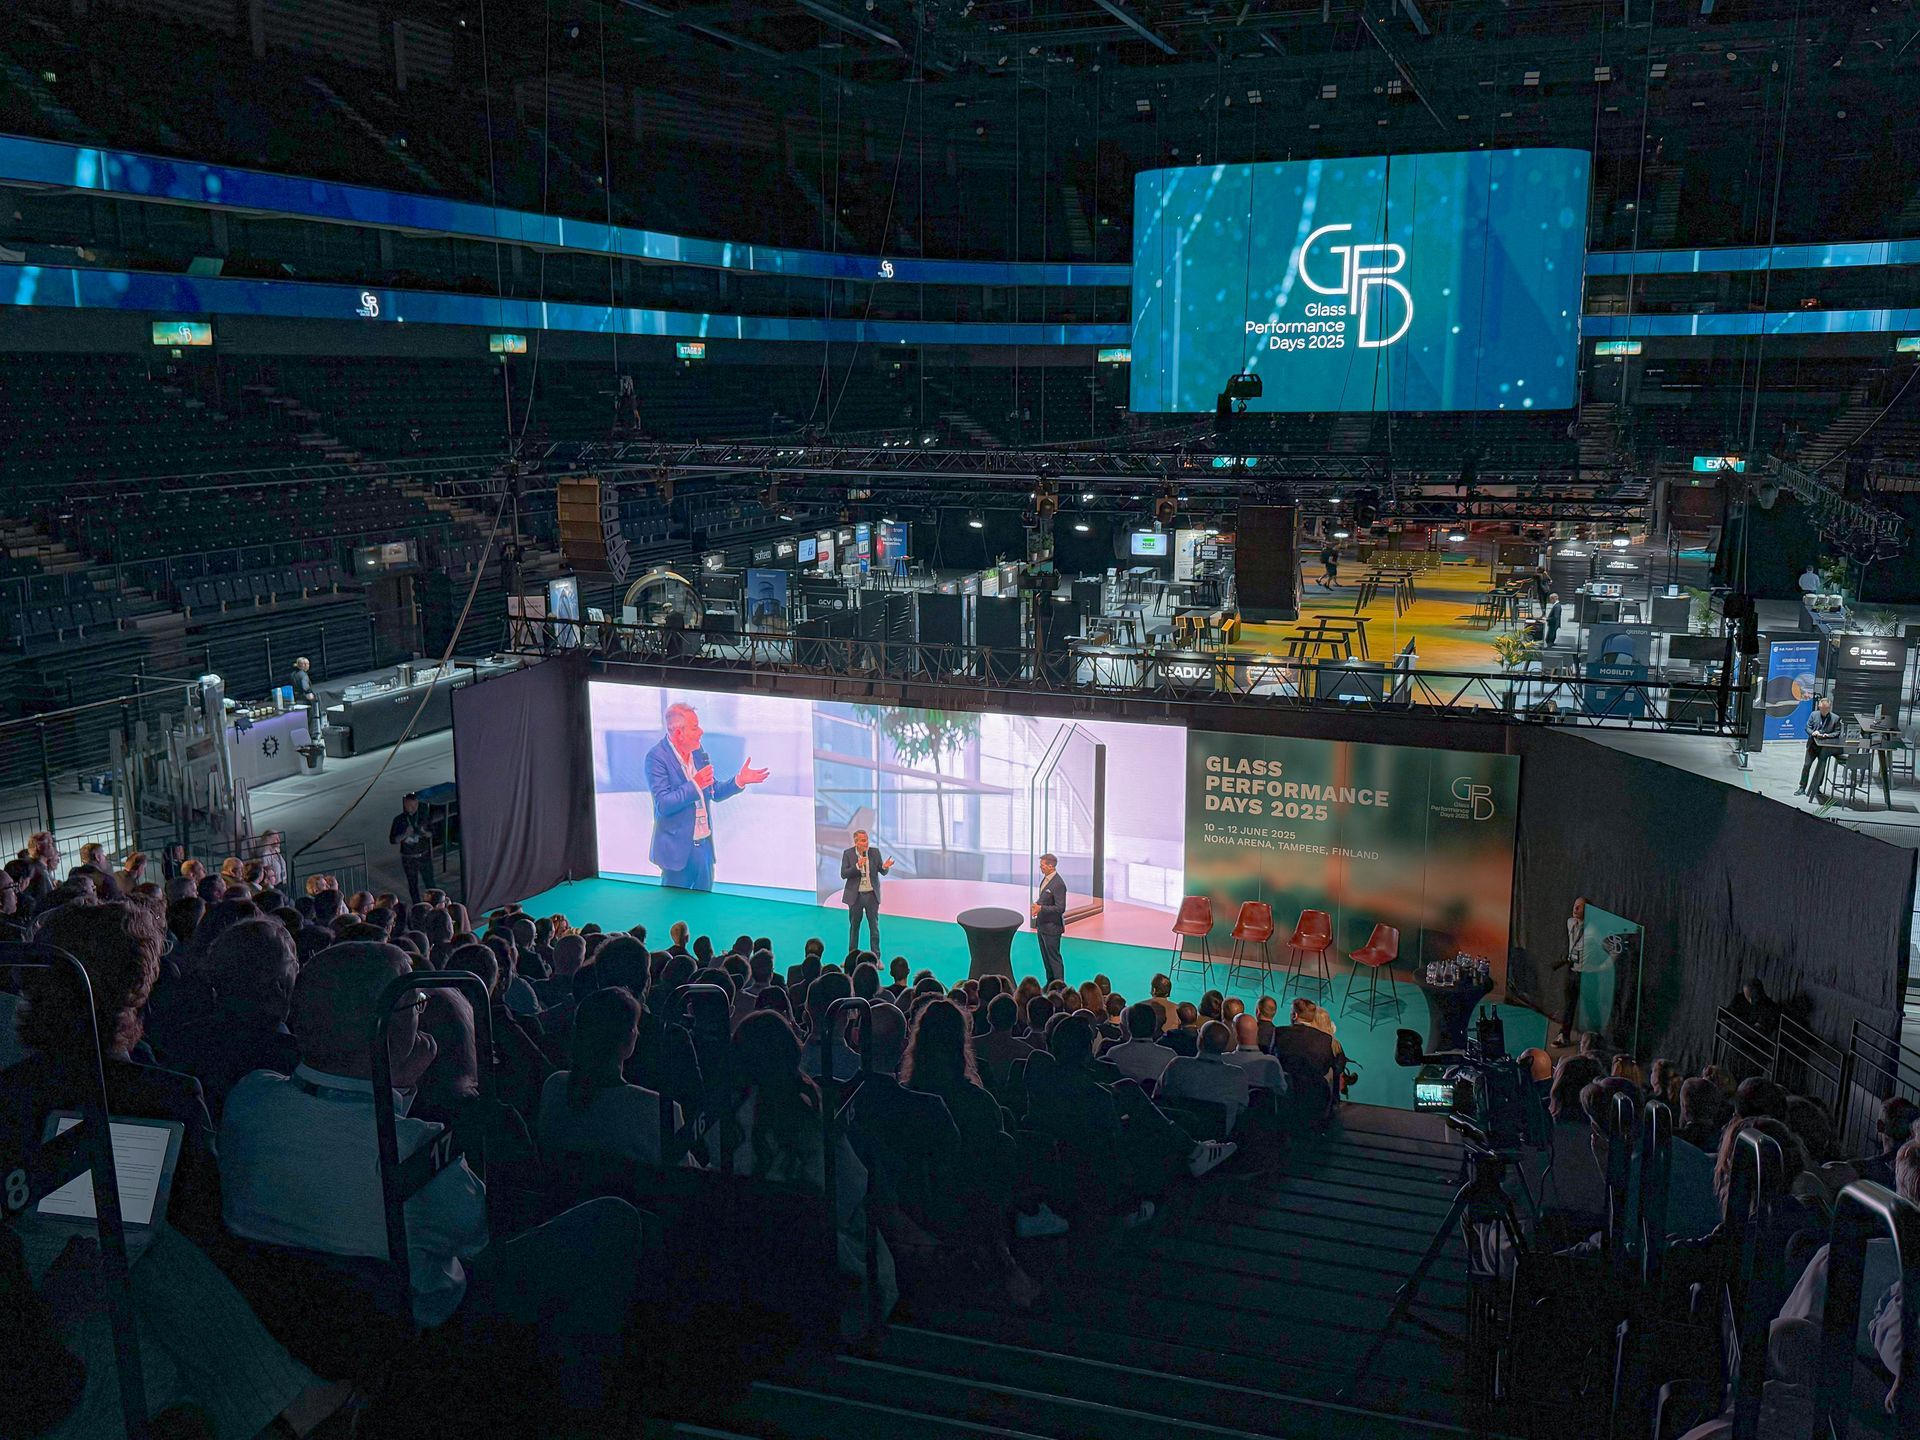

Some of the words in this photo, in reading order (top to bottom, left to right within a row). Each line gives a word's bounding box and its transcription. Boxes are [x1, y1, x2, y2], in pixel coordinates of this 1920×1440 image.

[1304, 302, 1346, 317] Glass
[1245, 320, 1346, 335] Performance
[1269, 336, 1306, 352] Days
[1308, 335, 1345, 349] 2025
[1600, 667, 1635, 677] MOBILITY
[1206, 755, 1283, 777] GLASS
[1206, 775, 1389, 808] PERFORMANCE
[1205, 794, 1263, 815] DAYS
[1270, 800, 1328, 821] 2025
[1204, 823, 1215, 832] 10
[1227, 825, 1238, 834] 12
[1240, 827, 1269, 837] JUNE
[1271, 829, 1296, 840] 2025
[1204, 834, 1235, 845] NOKIA
[1237, 838, 1275, 850] ARENA,
[1277, 841, 1329, 856] TAMPERE,
[1332, 847, 1379, 860] FINLAND
[430, 1129, 454, 1172] 17
